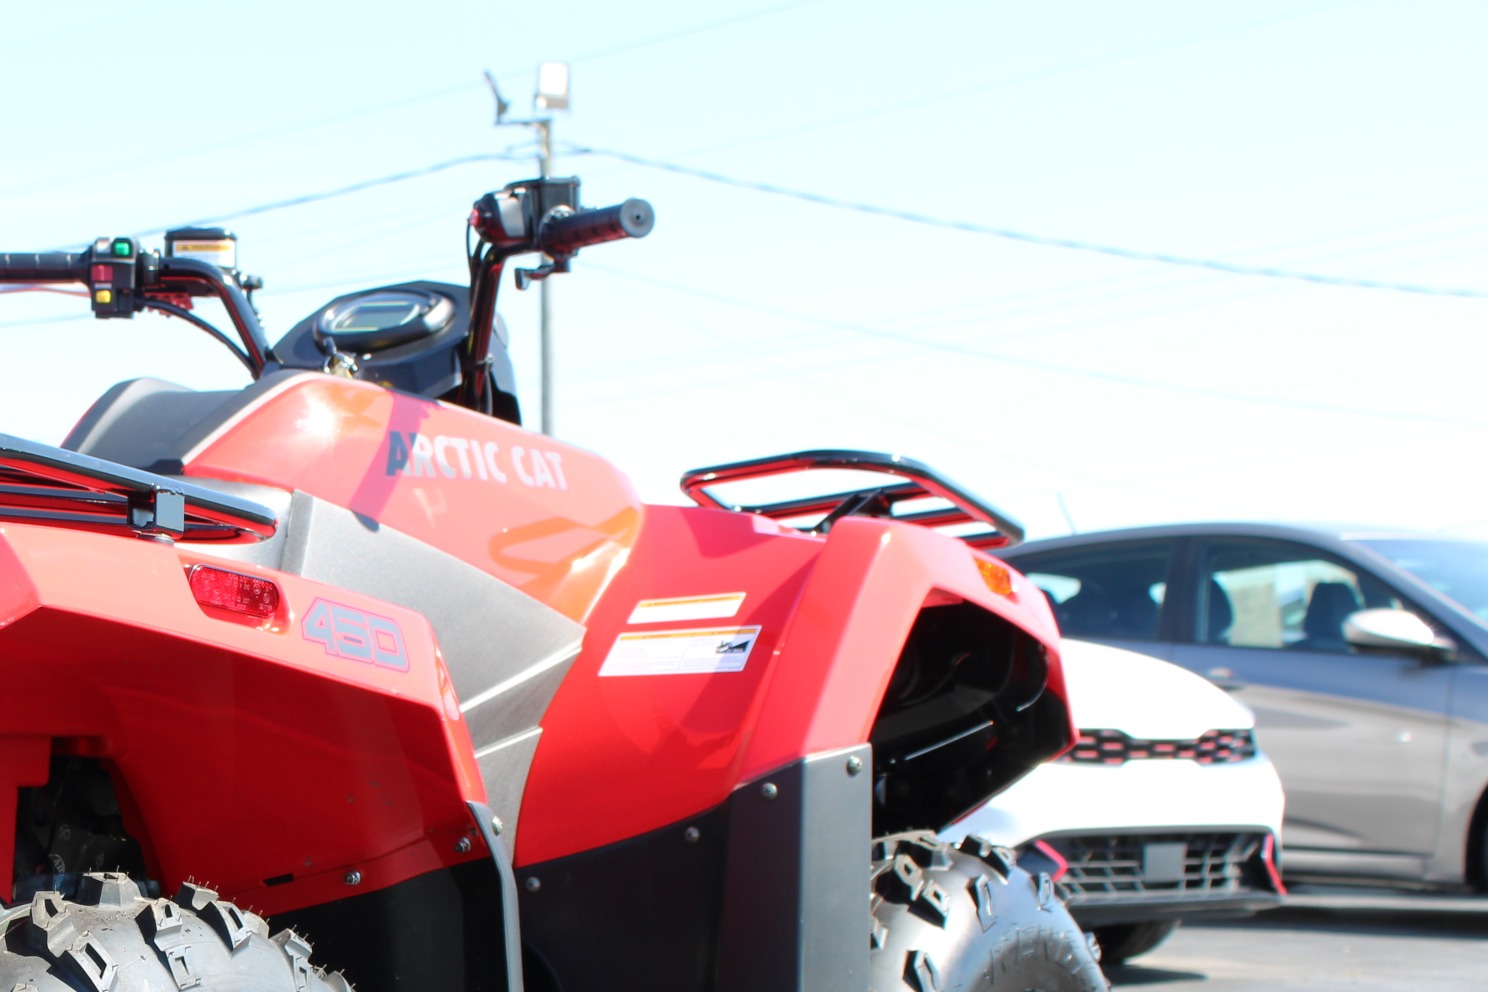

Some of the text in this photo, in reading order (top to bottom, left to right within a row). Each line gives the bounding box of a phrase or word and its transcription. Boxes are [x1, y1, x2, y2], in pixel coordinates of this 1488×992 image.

[385, 430, 568, 491] ARCTIC CAT
[302, 597, 409, 673] 450
